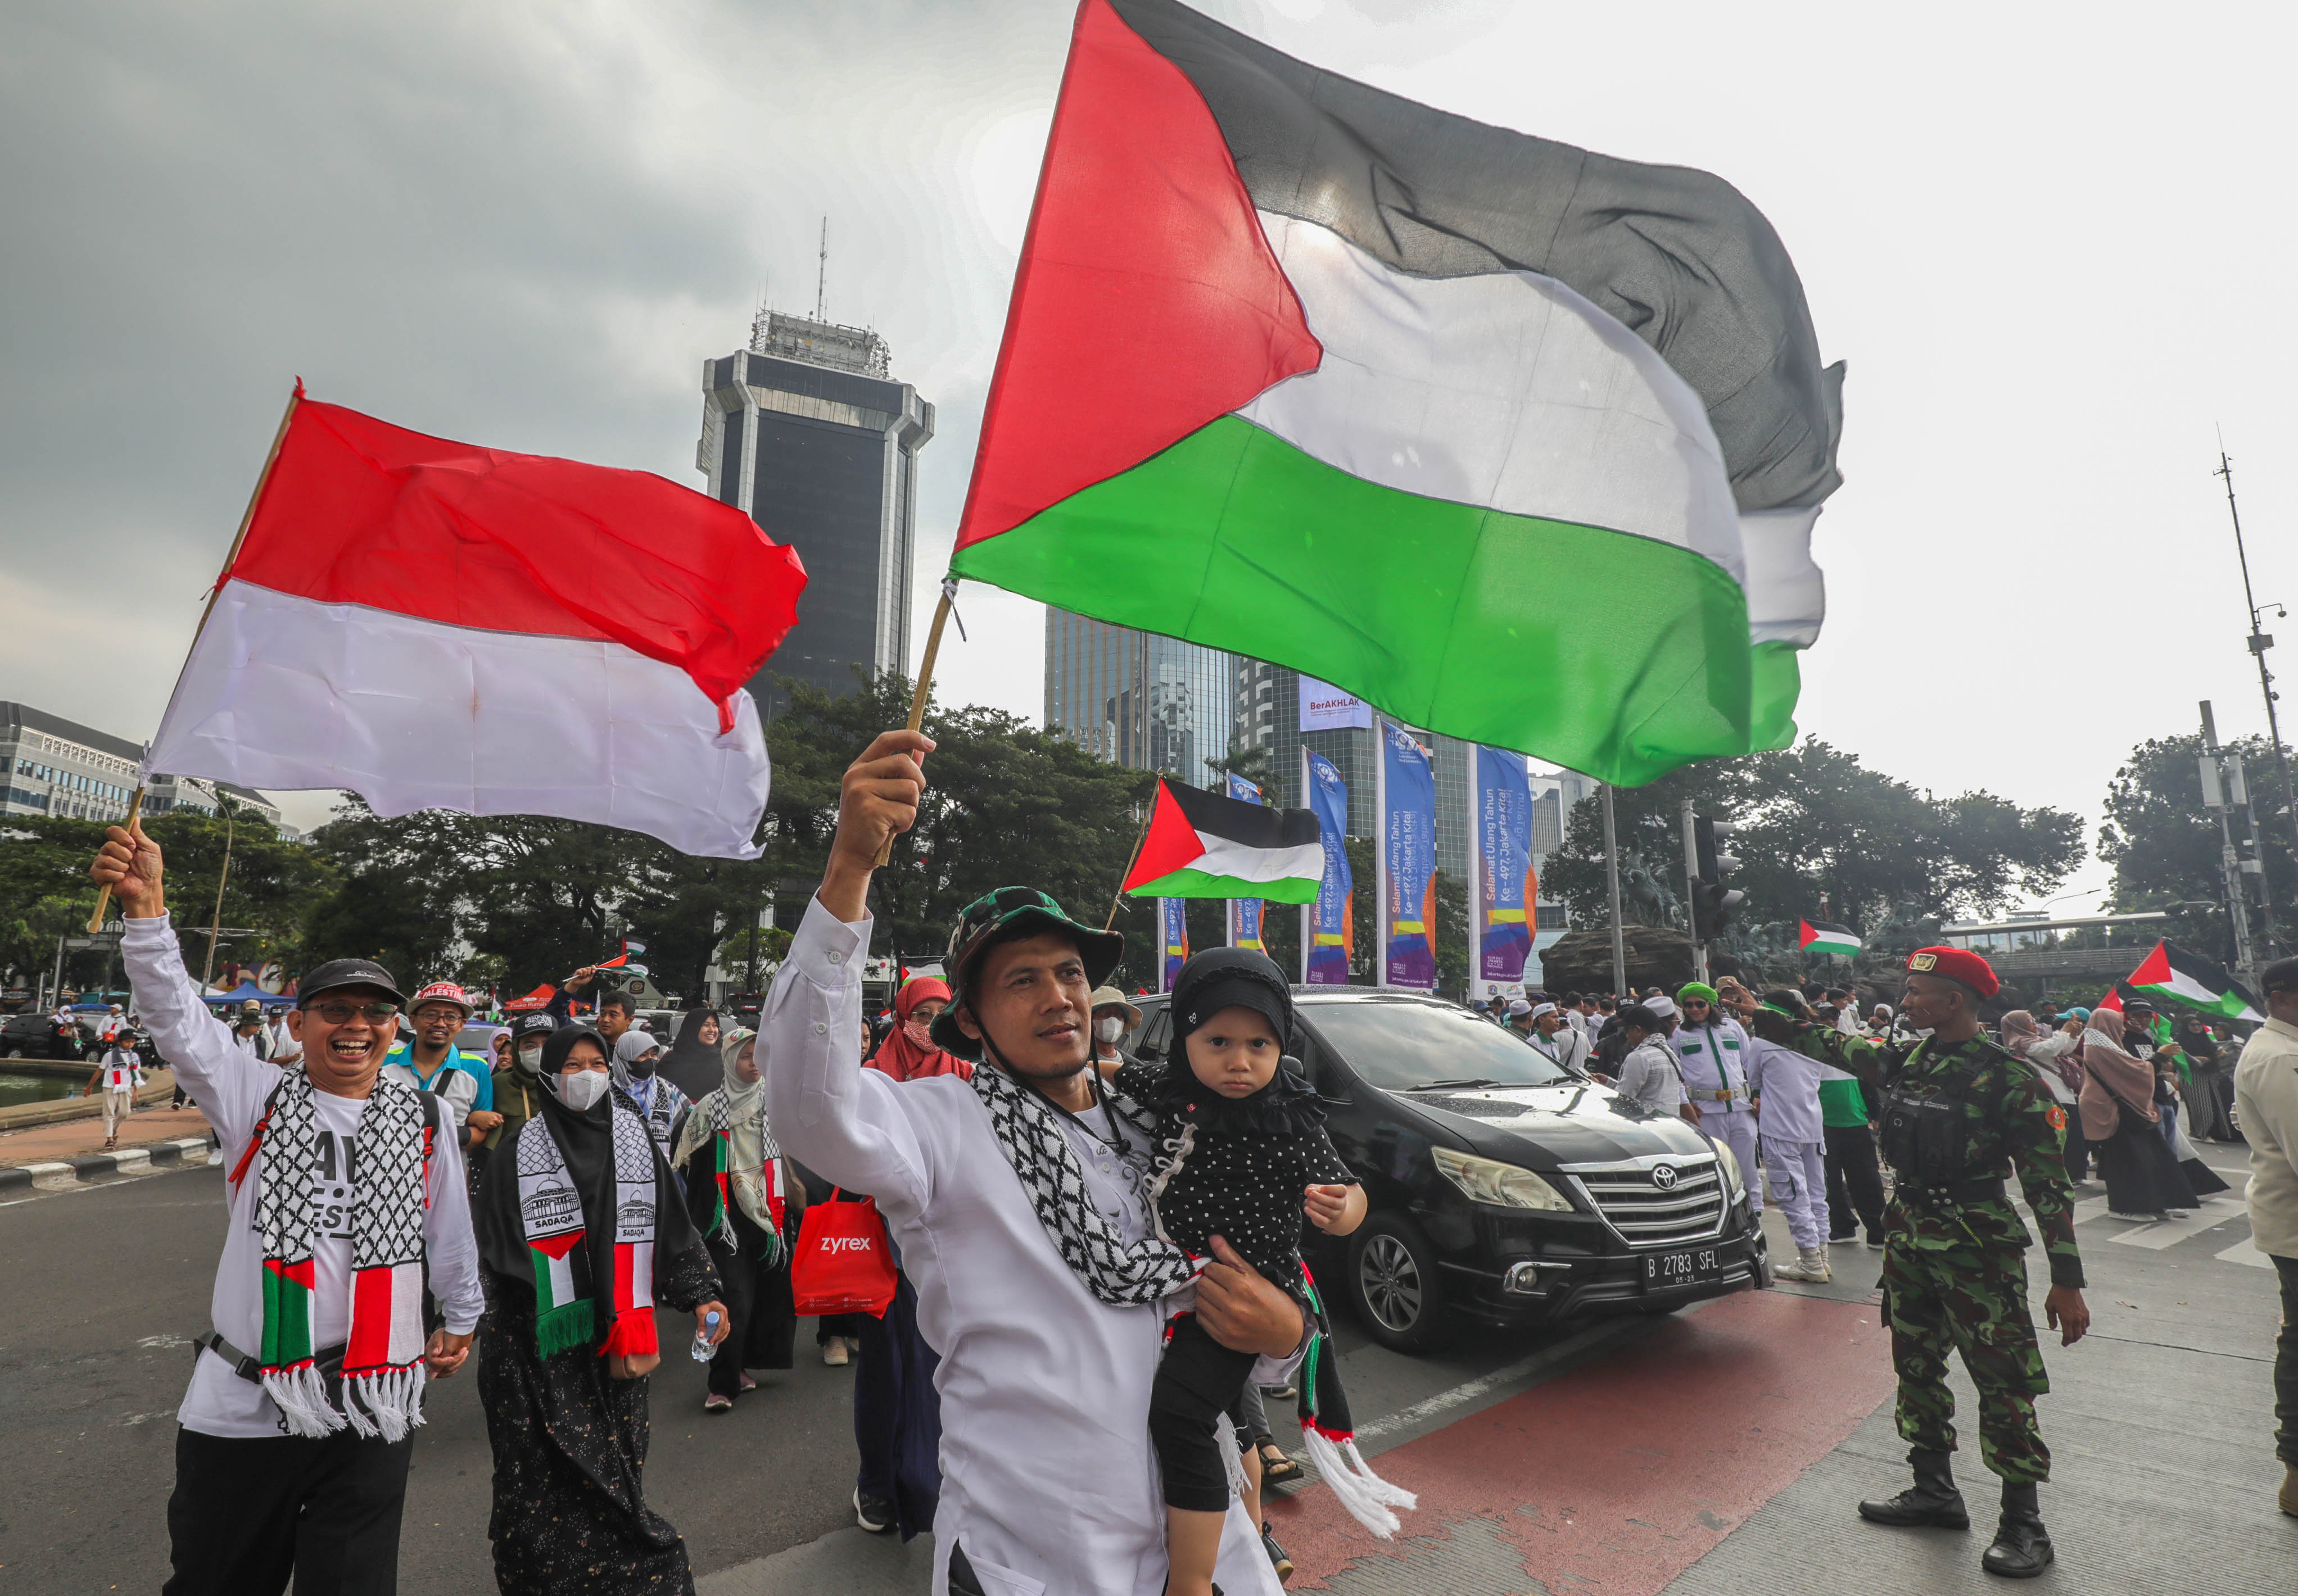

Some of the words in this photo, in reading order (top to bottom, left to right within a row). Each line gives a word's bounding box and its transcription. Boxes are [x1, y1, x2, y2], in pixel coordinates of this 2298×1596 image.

[1310, 698, 1359, 710] BerAKHLAK
[1485, 789, 1494, 821] Tahun
[1498, 788, 1507, 813] Kita!
[1486, 822, 1496, 853] Ulang
[1499, 815, 1509, 855] Jakarta
[1391, 844, 1401, 869] Ulang
[1403, 835, 1412, 874] Jakarta
[1486, 855, 1495, 901] Selamat
[1392, 872, 1400, 913] Selamat
[535, 1214, 574, 1228] SADAQA
[623, 1228, 645, 1237] SADAQA
[820, 1237, 871, 1254] zyrex
[1648, 1259, 1655, 1277] B
[1664, 1254, 1691, 1275] 2783
[1699, 1250, 1718, 1270] SFL
